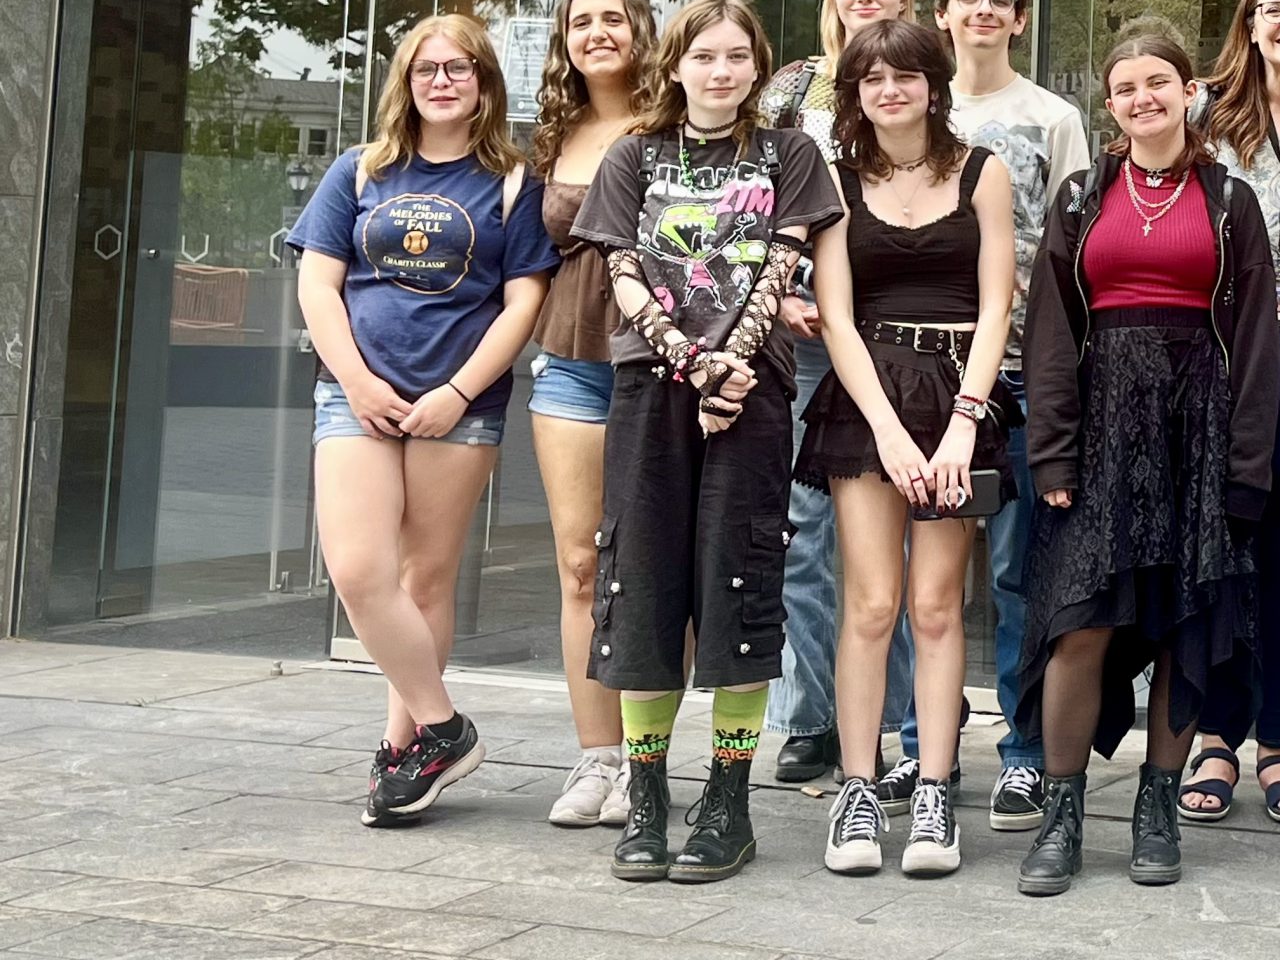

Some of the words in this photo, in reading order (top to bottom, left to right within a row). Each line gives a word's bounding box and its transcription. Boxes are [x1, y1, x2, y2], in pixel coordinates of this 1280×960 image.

[389, 208, 453, 221] MELODIES
[407, 219, 443, 233] FALL
[713, 735, 758, 750] SOUR
